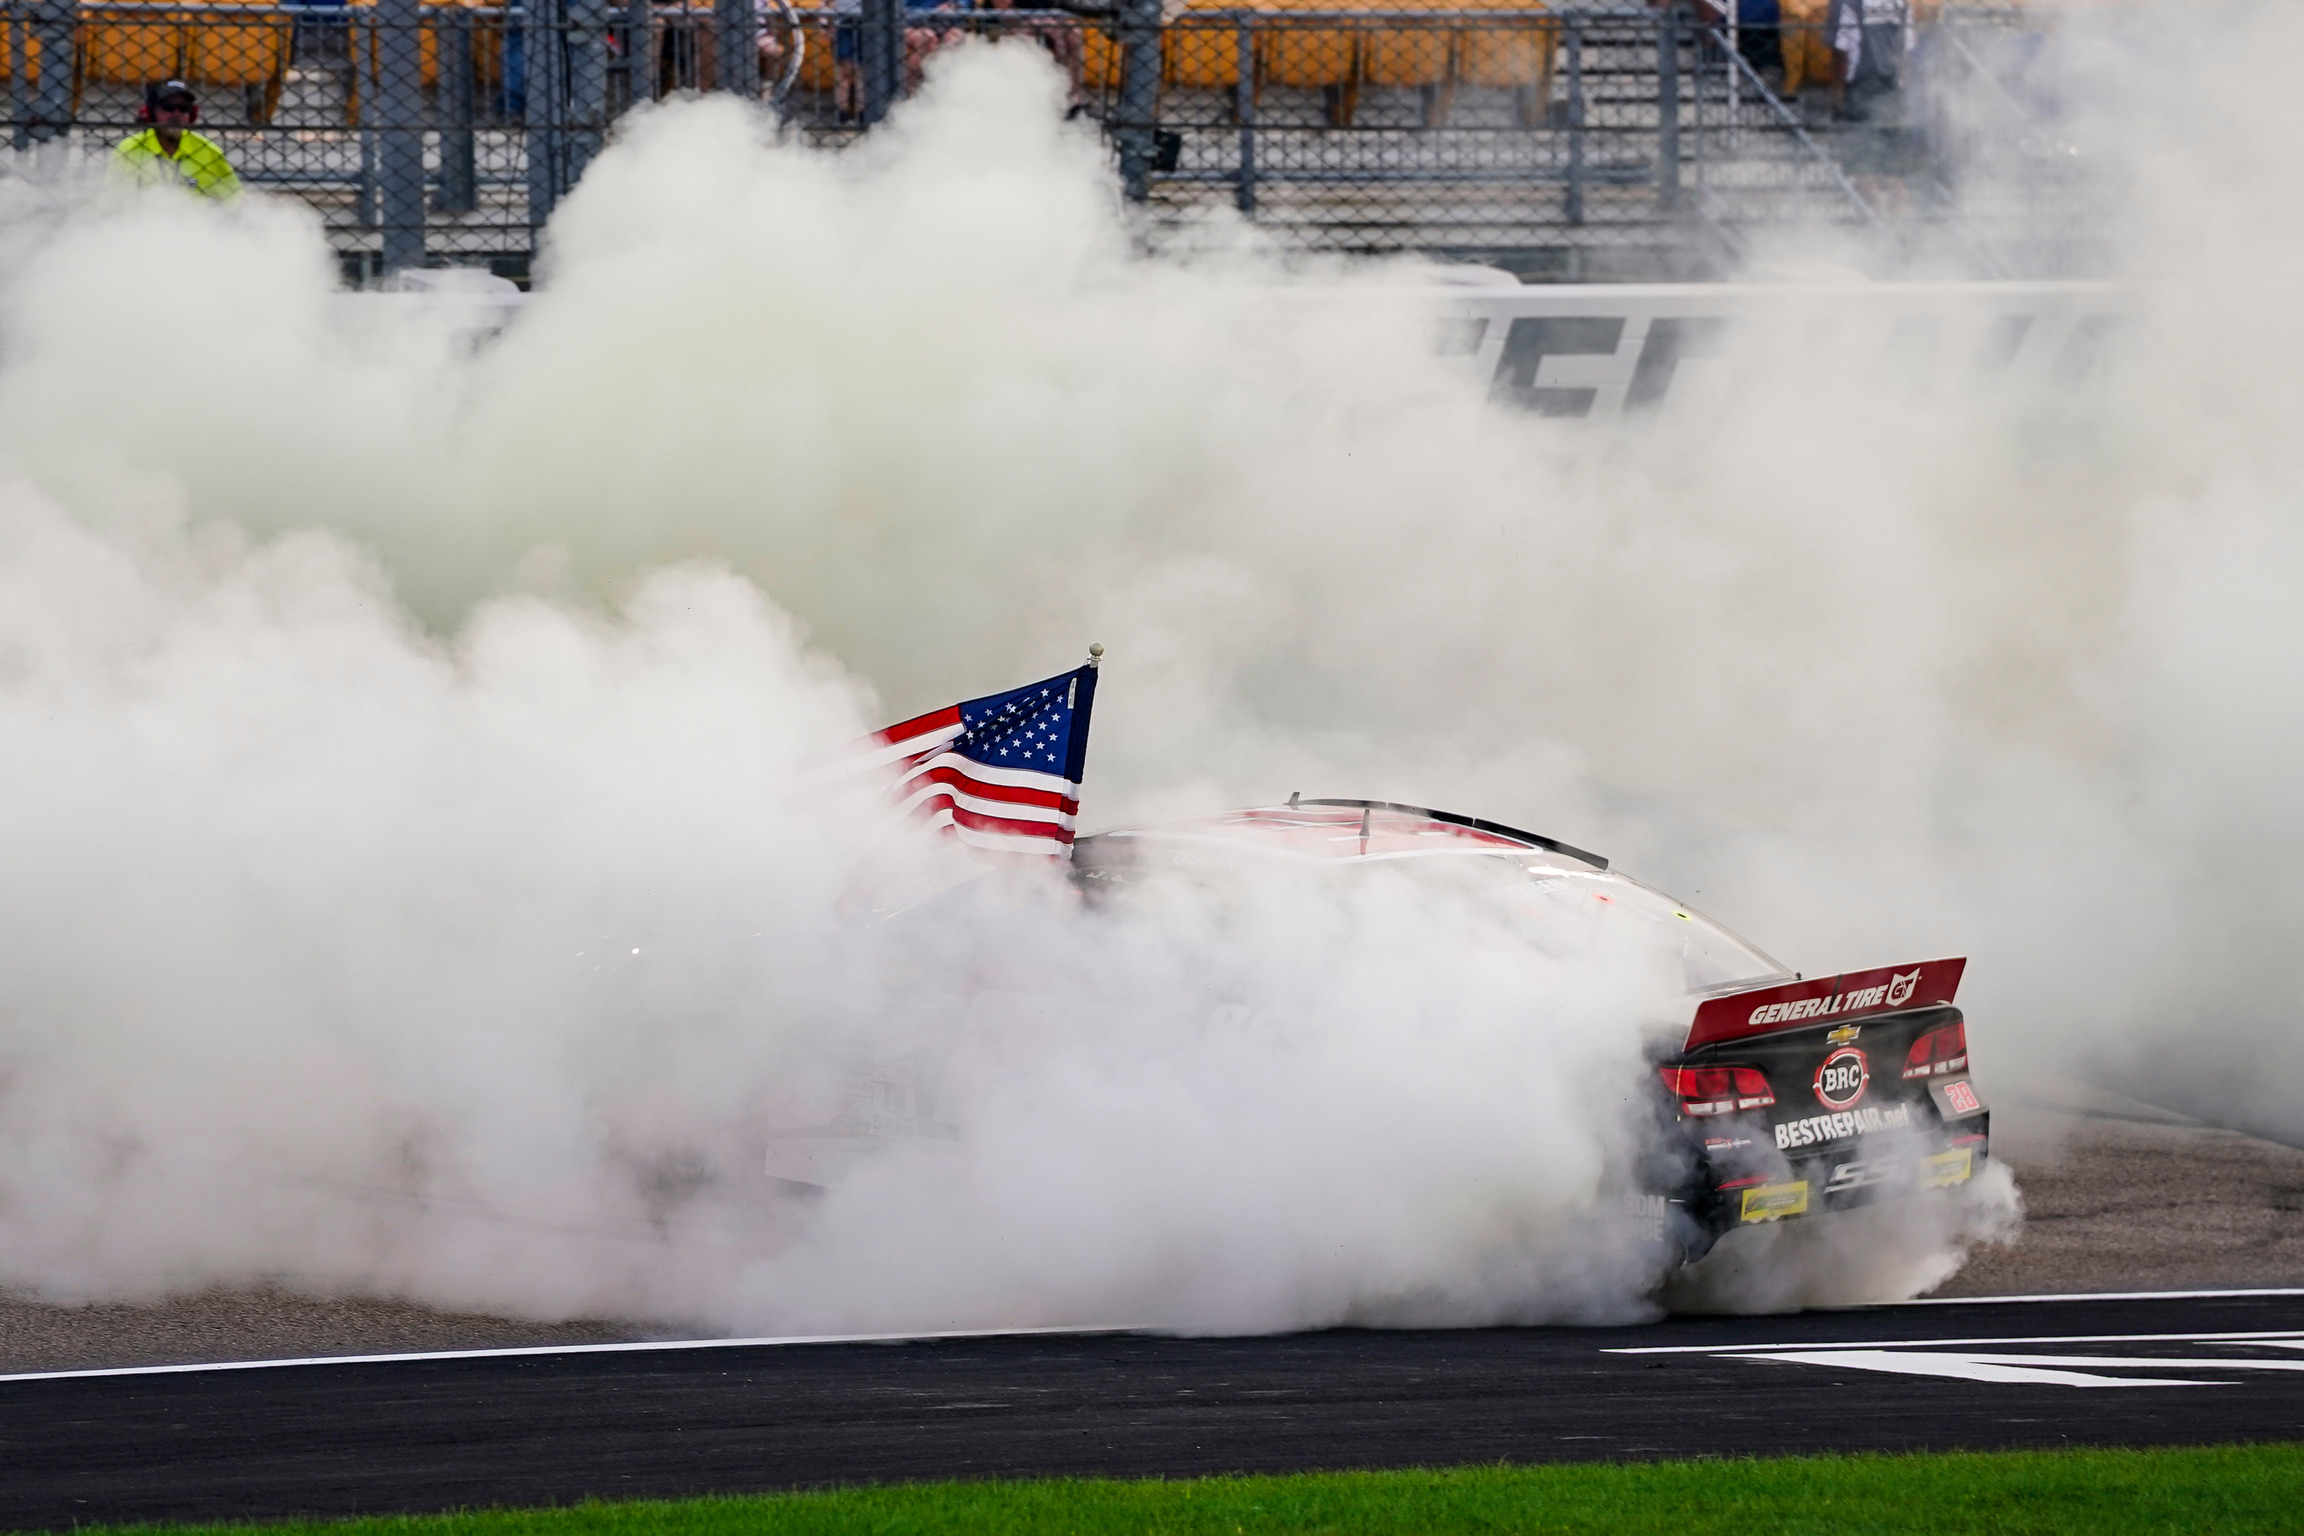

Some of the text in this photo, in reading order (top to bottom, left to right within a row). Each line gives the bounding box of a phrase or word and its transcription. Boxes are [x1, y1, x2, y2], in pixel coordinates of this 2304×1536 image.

[1748, 984, 1889, 1025] GENERAL TIRE
[1824, 1064, 1860, 1092] BRC
[1943, 1080, 1980, 1114] 28
[1774, 1102, 1910, 1149] BESTREPAIR.net
